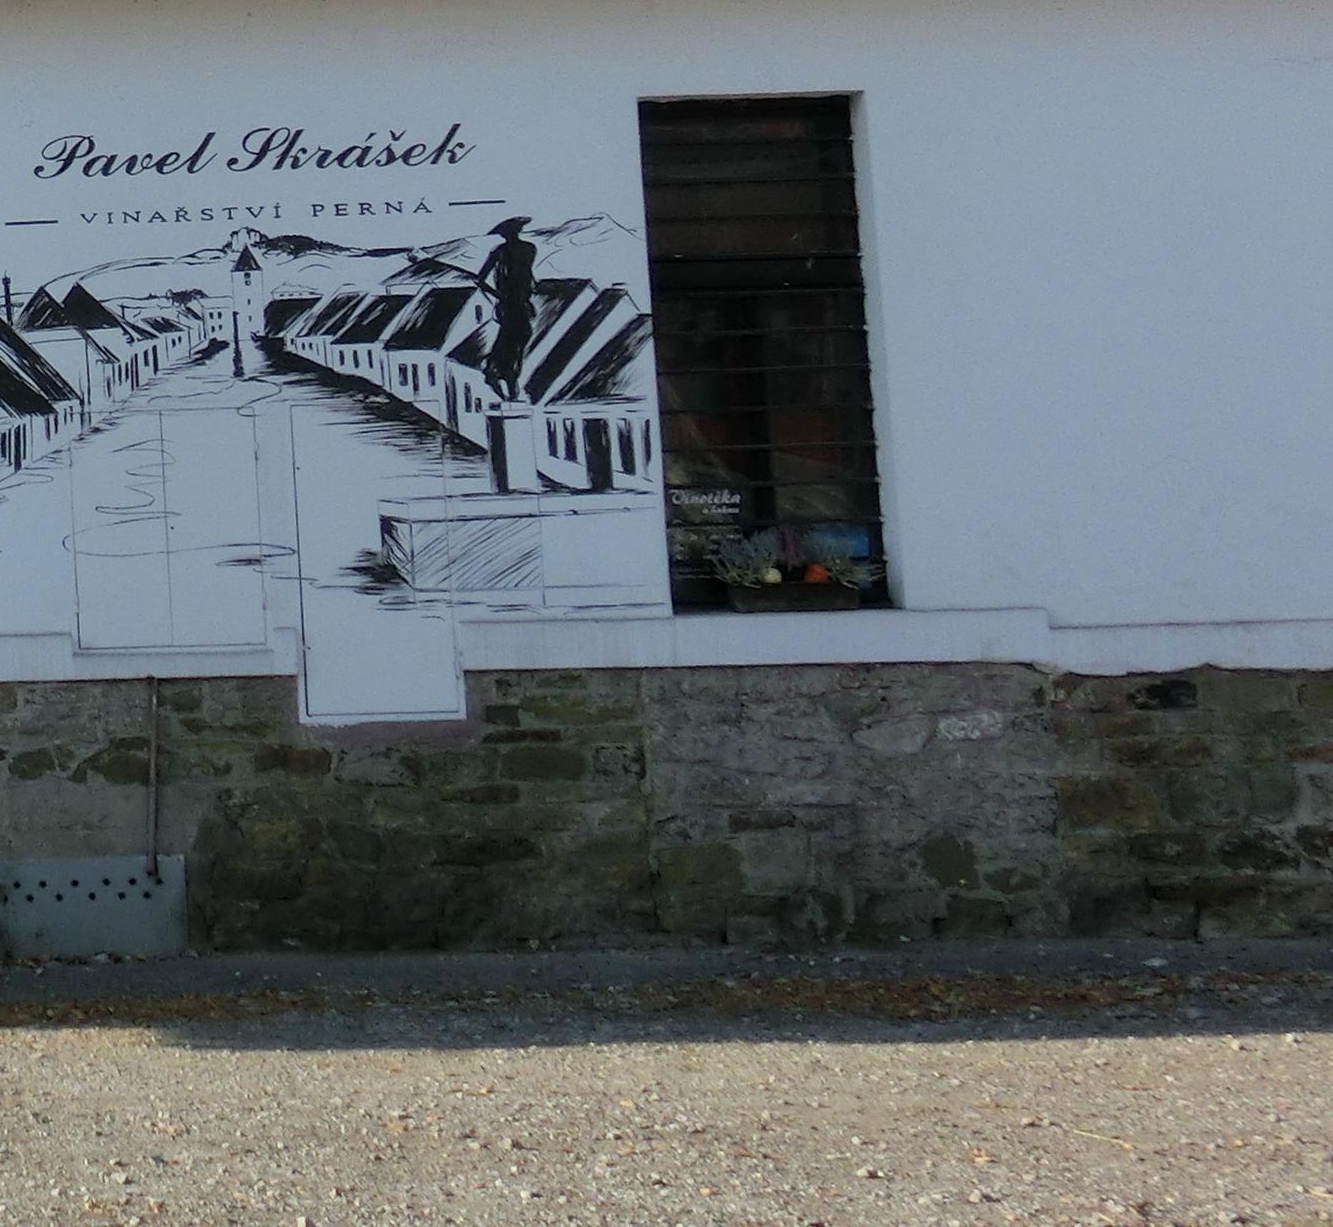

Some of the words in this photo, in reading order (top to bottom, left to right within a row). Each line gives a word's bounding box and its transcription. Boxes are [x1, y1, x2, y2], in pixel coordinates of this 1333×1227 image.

[33, 131, 217, 180] Pavel
[227, 123, 476, 172] Skrášek
[81, 202, 282, 224] VINAŘSTVÍ
[312, 197, 434, 217] PERNÁ
